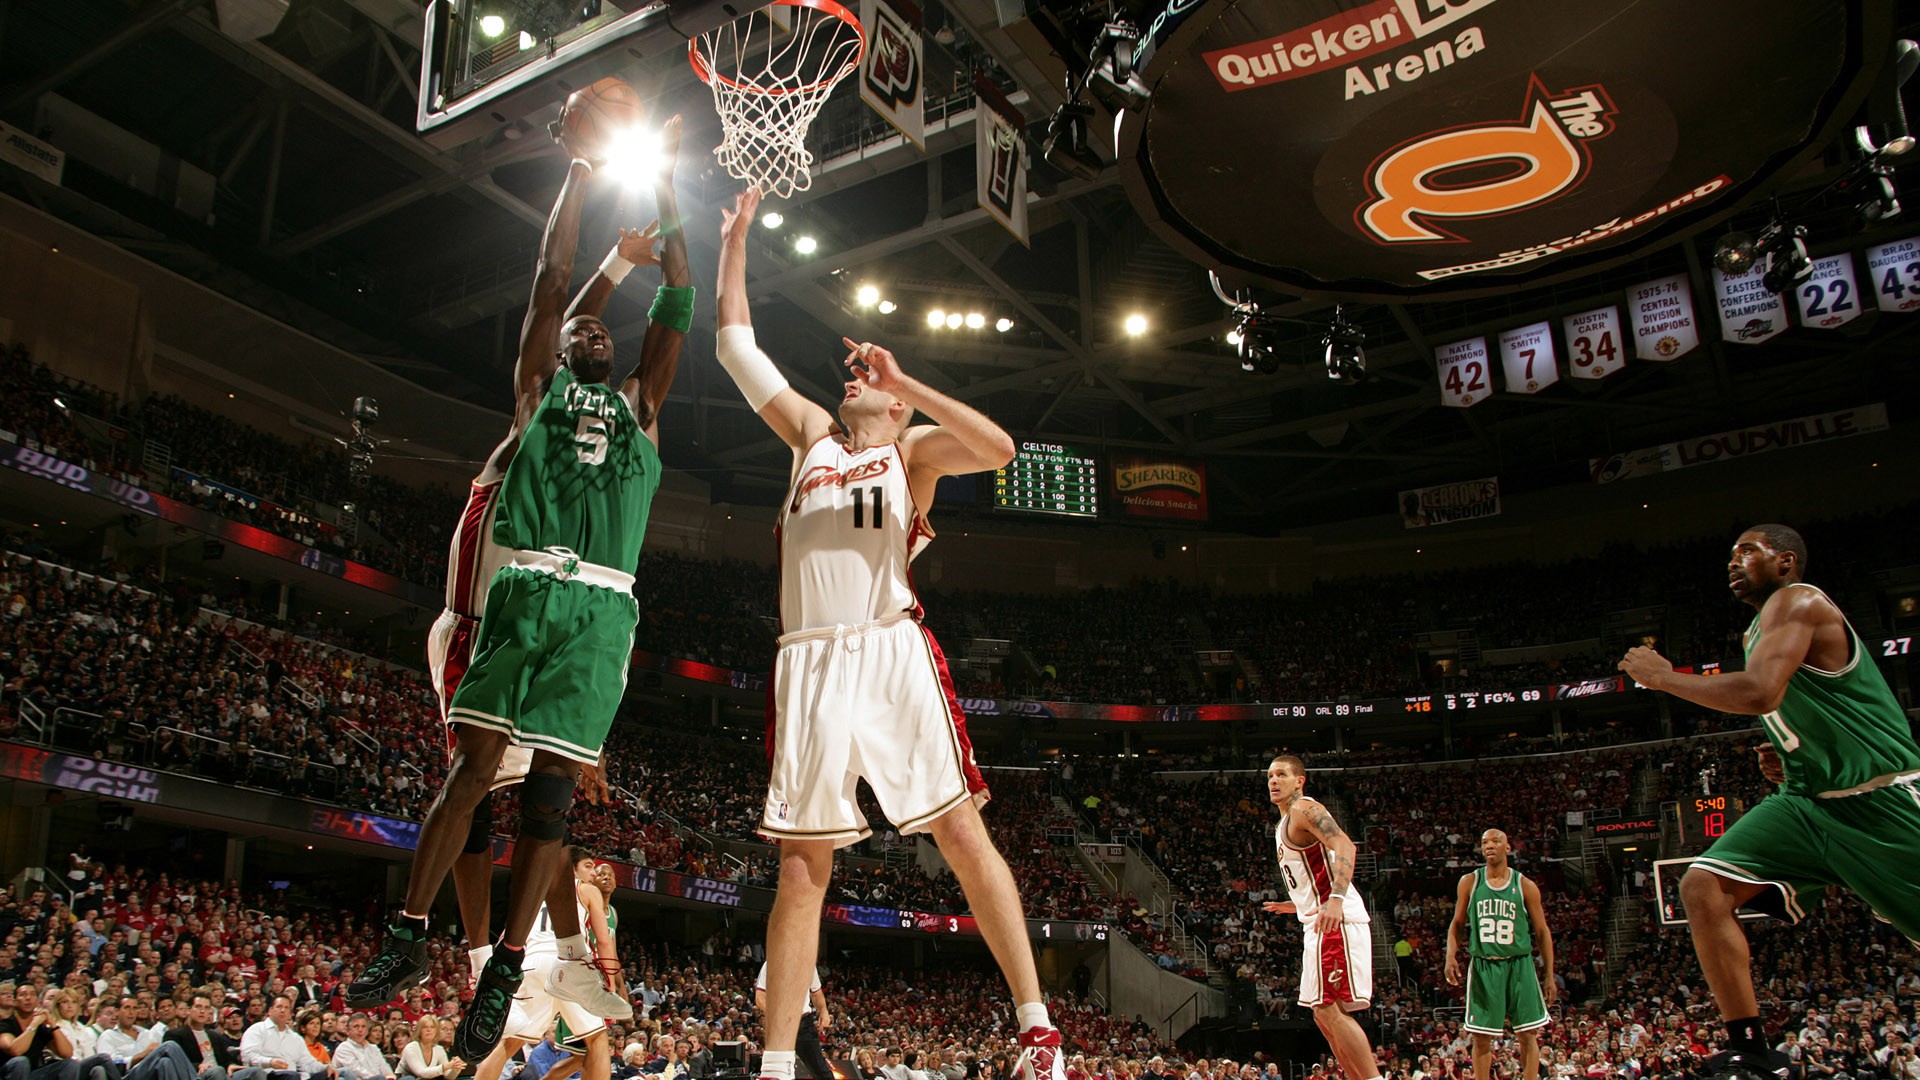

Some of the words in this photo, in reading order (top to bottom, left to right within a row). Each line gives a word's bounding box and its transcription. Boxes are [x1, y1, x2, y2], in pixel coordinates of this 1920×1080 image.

[1132, 10, 1167, 66] BUD
[1217, 12, 1401, 85] Quicken
[1344, 25, 1486, 100] Arena
[1549, 90, 1605, 137] The
[1882, 242, 1913, 256] BRAD
[1812, 259, 1840, 271] ARRY
[1726, 280, 1764, 294] EASTER
[1882, 262, 1920, 299] 43
[1637, 282, 1679, 300] 1975-76
[1803, 279, 1853, 318] 22
[1640, 296, 1680, 312] CENTRAL
[1724, 299, 1779, 319] CHAMPIONS
[1572, 312, 1608, 327] AUSTIN
[1643, 307, 1682, 324] DIVISION
[1578, 322, 1605, 334] CARR
[1638, 317, 1690, 337] CHAMPIONS
[1449, 343, 1472, 355] NATE
[1510, 336, 1541, 350] SMITH
[1573, 331, 1617, 367] 34
[1439, 349, 1484, 366] THURMOND
[1519, 348, 1536, 380] 7
[1445, 361, 1485, 395] 42
[575, 415, 609, 467] 5
[1677, 411, 1858, 465] LOUDVILLE
[1022, 442, 1064, 454] CELTICS
[1019, 452, 1031, 460] RB
[1045, 455, 1063, 463] FG%
[1065, 456, 1081, 465] FT%
[1084, 458, 1095, 466] BK
[1119, 468, 1197, 489] SHEARER'S
[1052, 493, 1065, 501] 100
[1122, 495, 1165, 507] Delicious
[1166, 500, 1198, 511] Snacks
[1421, 481, 1497, 509] LEBRON'S
[849, 486, 883, 529] 11
[1425, 498, 1496, 523] KINGDOM
[1882, 636, 1912, 656] 27
[1404, 701, 1432, 713] +18
[1447, 698, 1457, 710] 5
[1466, 698, 1477, 709] 2
[1484, 691, 1515, 704] FG%
[1521, 690, 1541, 701] 69
[1273, 708, 1289, 717] DET
[1292, 705, 1306, 717] 90
[1315, 707, 1332, 715] ORL
[1335, 704, 1350, 716] 89
[1355, 704, 1373, 714] Final
[1695, 796, 1727, 812] 5:40
[1596, 819, 1657, 832] PONTIAC
[1703, 812, 1725, 837] 18
[899, 910, 914, 918] FG%
[1476, 898, 1517, 920] CELTICS
[901, 919, 911, 928] 69
[949, 918, 959, 932] 3
[1042, 923, 1051, 937] 1
[1479, 918, 1514, 945] 28
